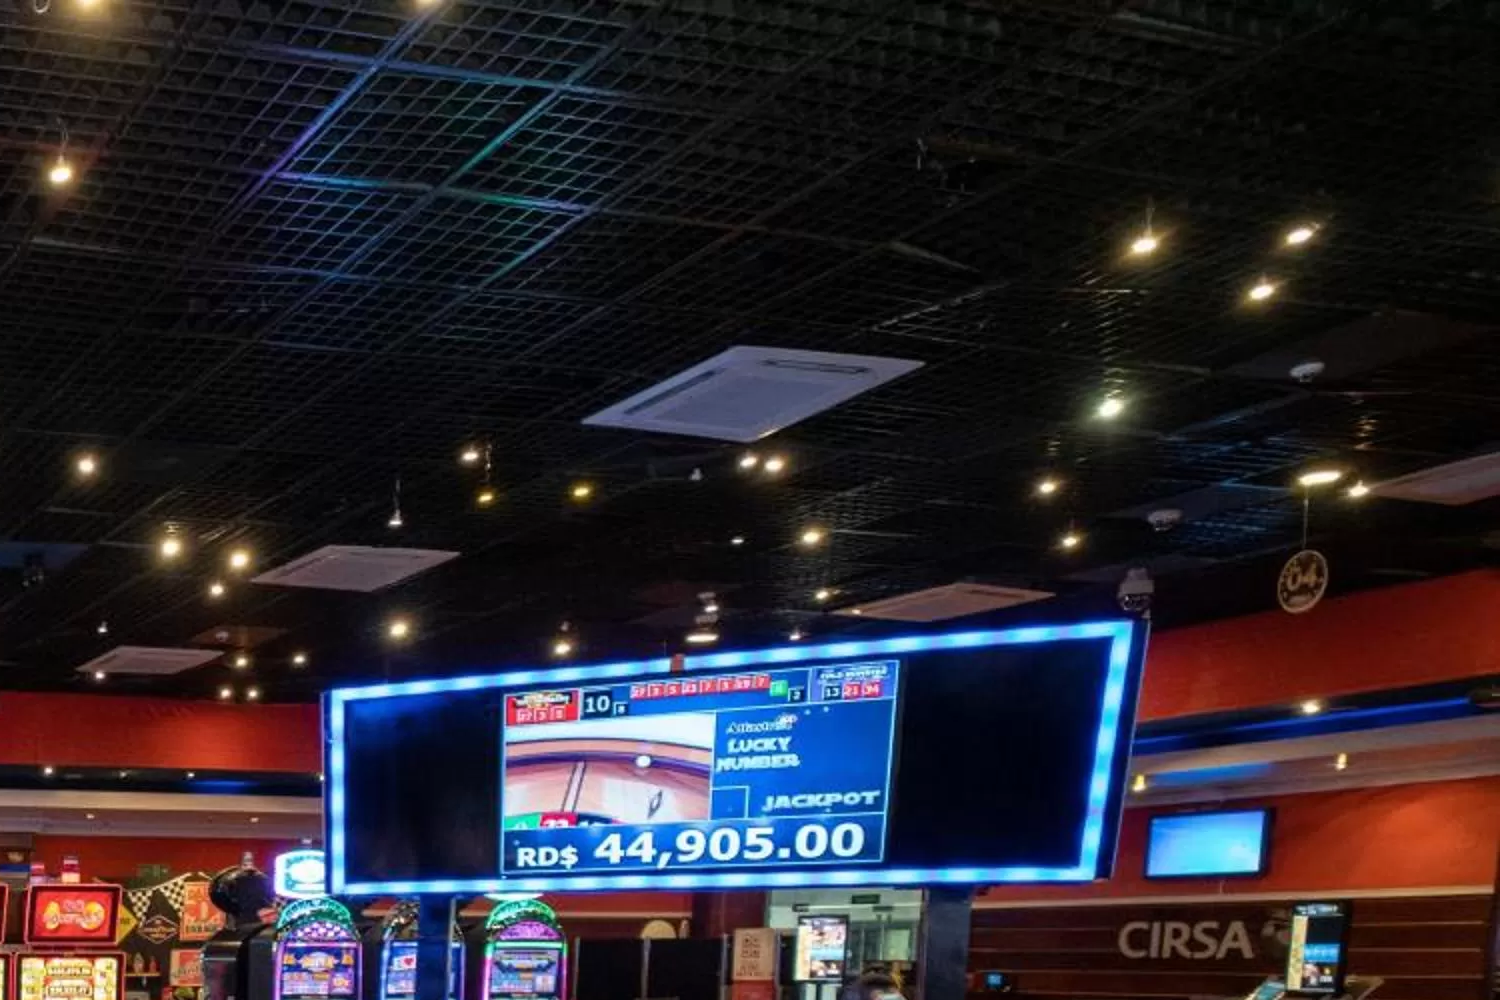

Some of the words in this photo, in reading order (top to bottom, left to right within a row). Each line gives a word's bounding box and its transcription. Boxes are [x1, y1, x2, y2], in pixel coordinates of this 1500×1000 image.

[585, 695, 610, 713] 10
[727, 736, 792, 754] LUCKY
[716, 753, 800, 772] NUMBER
[761, 790, 881, 812] JACKPOT
[516, 845, 578, 869] RD$
[593, 823, 865, 869] 44,905.00
[1117, 920, 1255, 960] CIRSA
